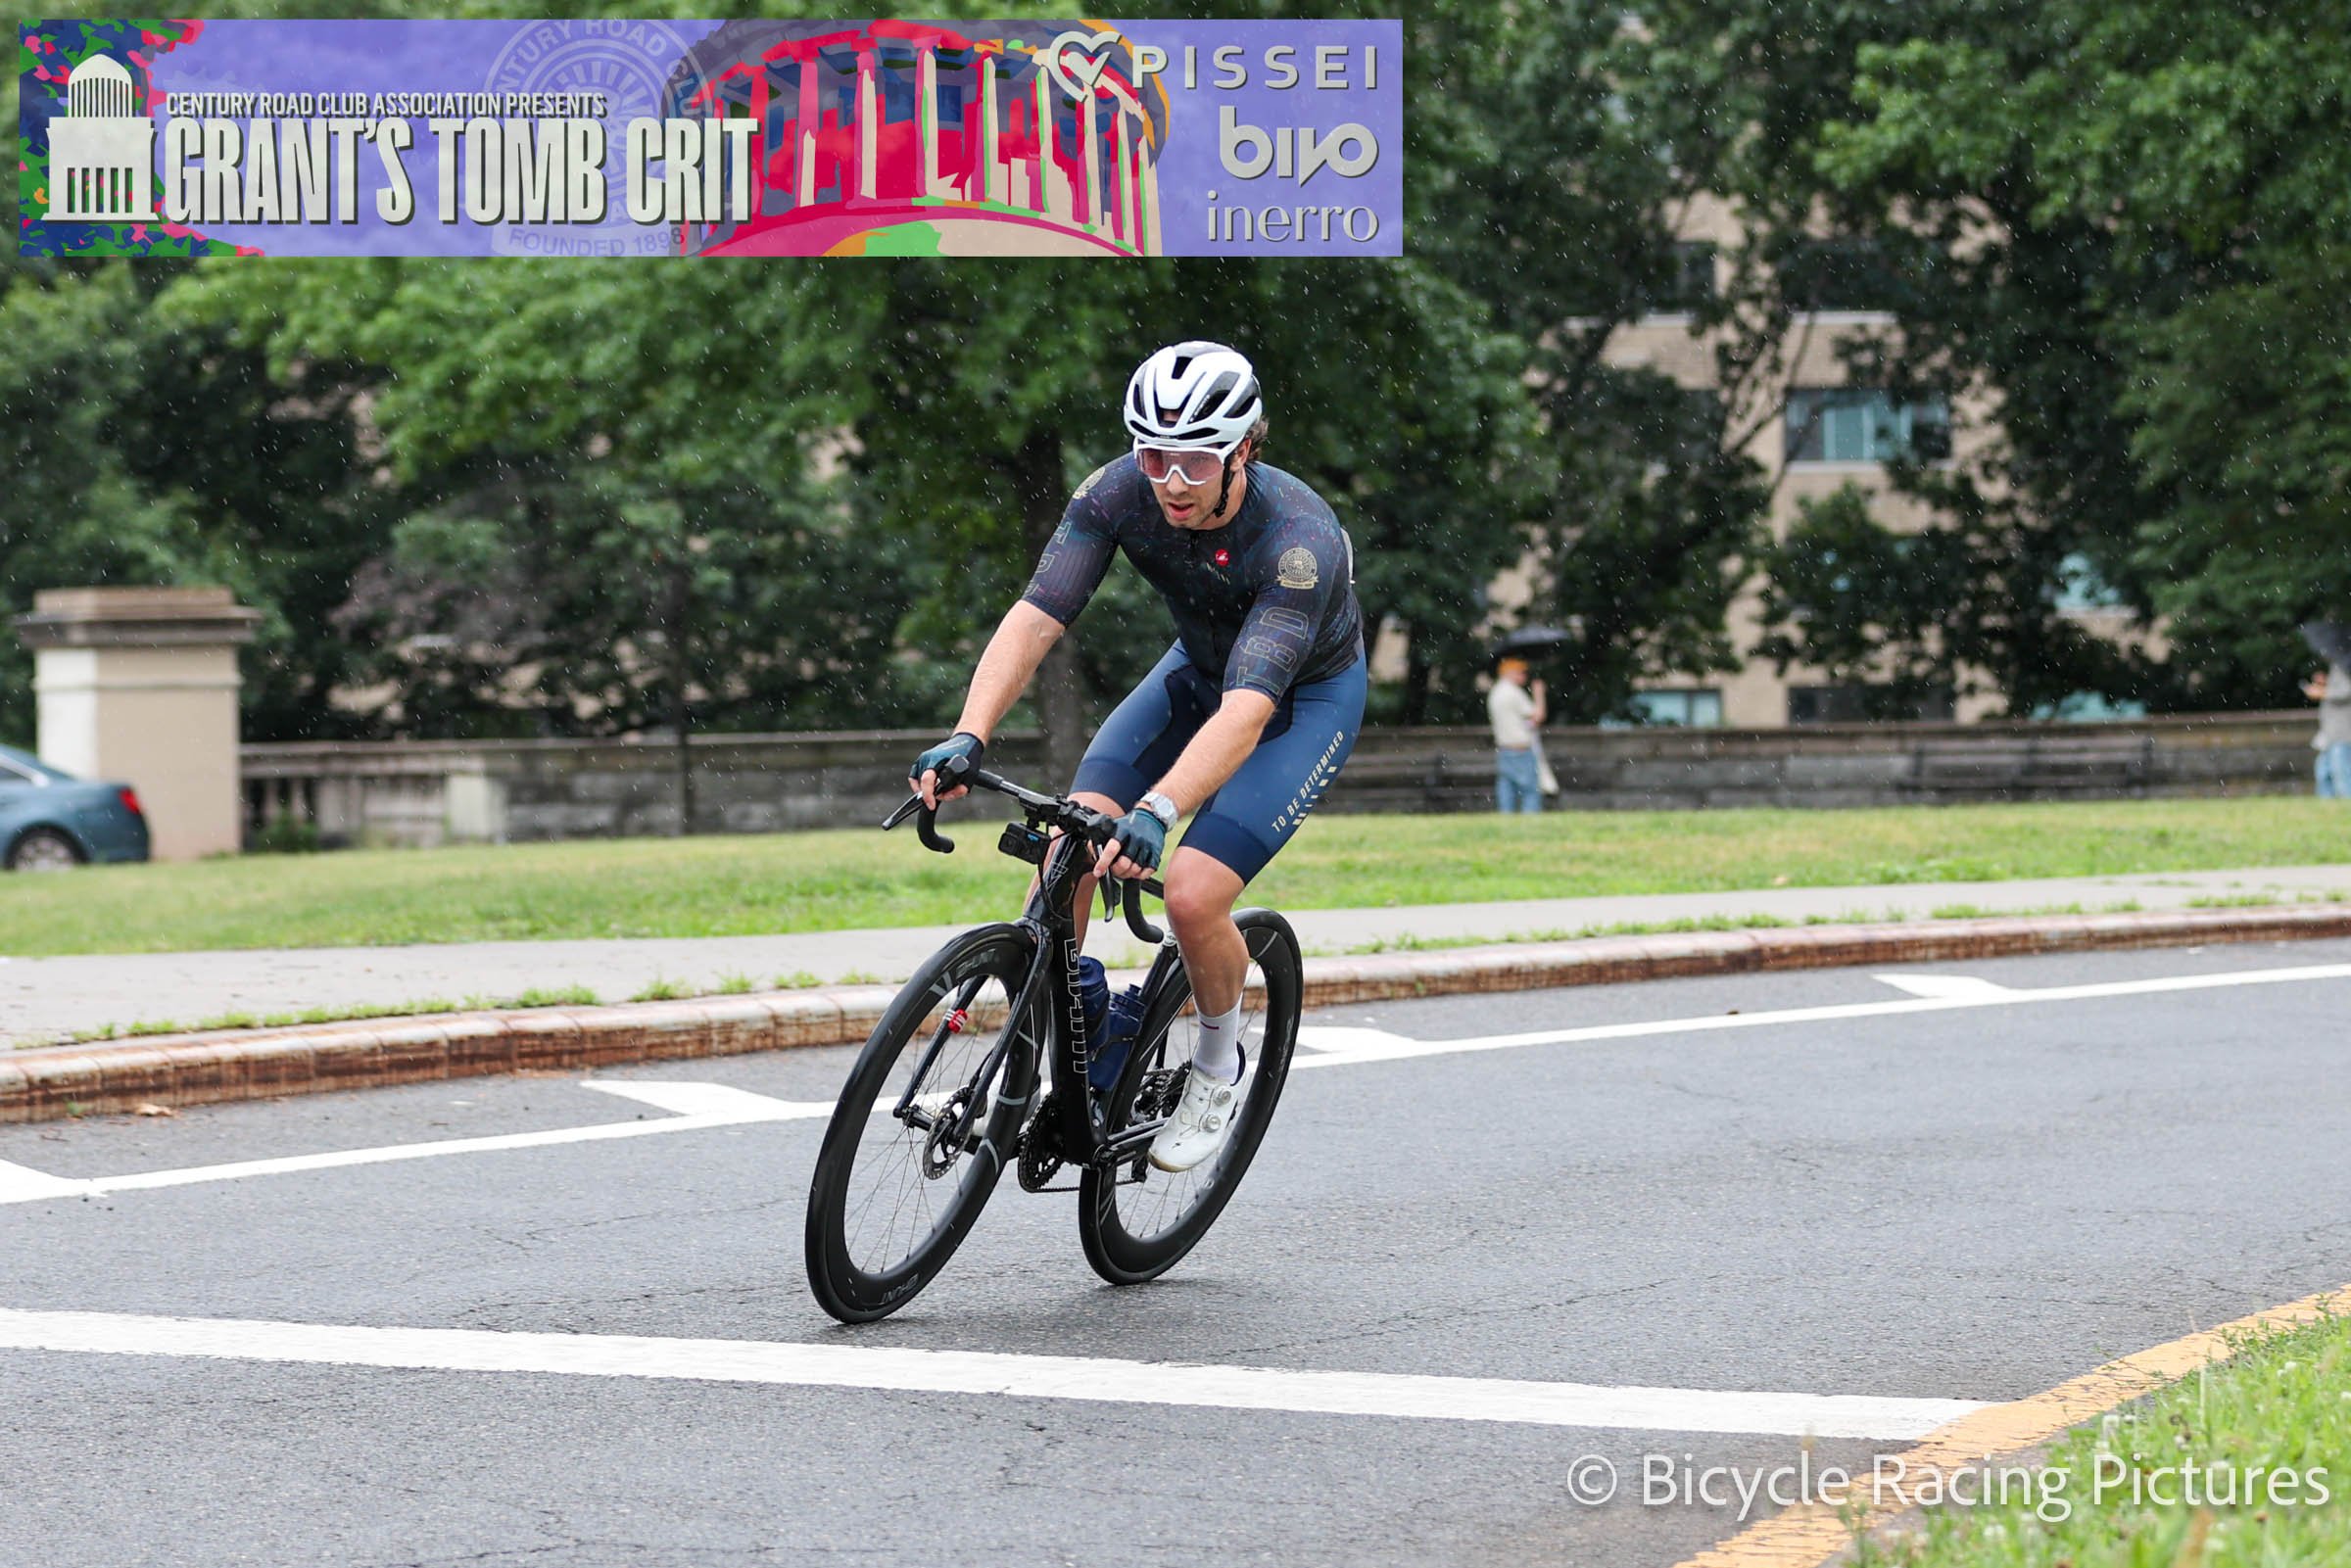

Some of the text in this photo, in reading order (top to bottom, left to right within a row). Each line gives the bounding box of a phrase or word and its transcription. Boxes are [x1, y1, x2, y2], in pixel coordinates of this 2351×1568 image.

[1235, 605, 1310, 695] TBD
[1271, 731, 1344, 832] TO BE DETERMINED
